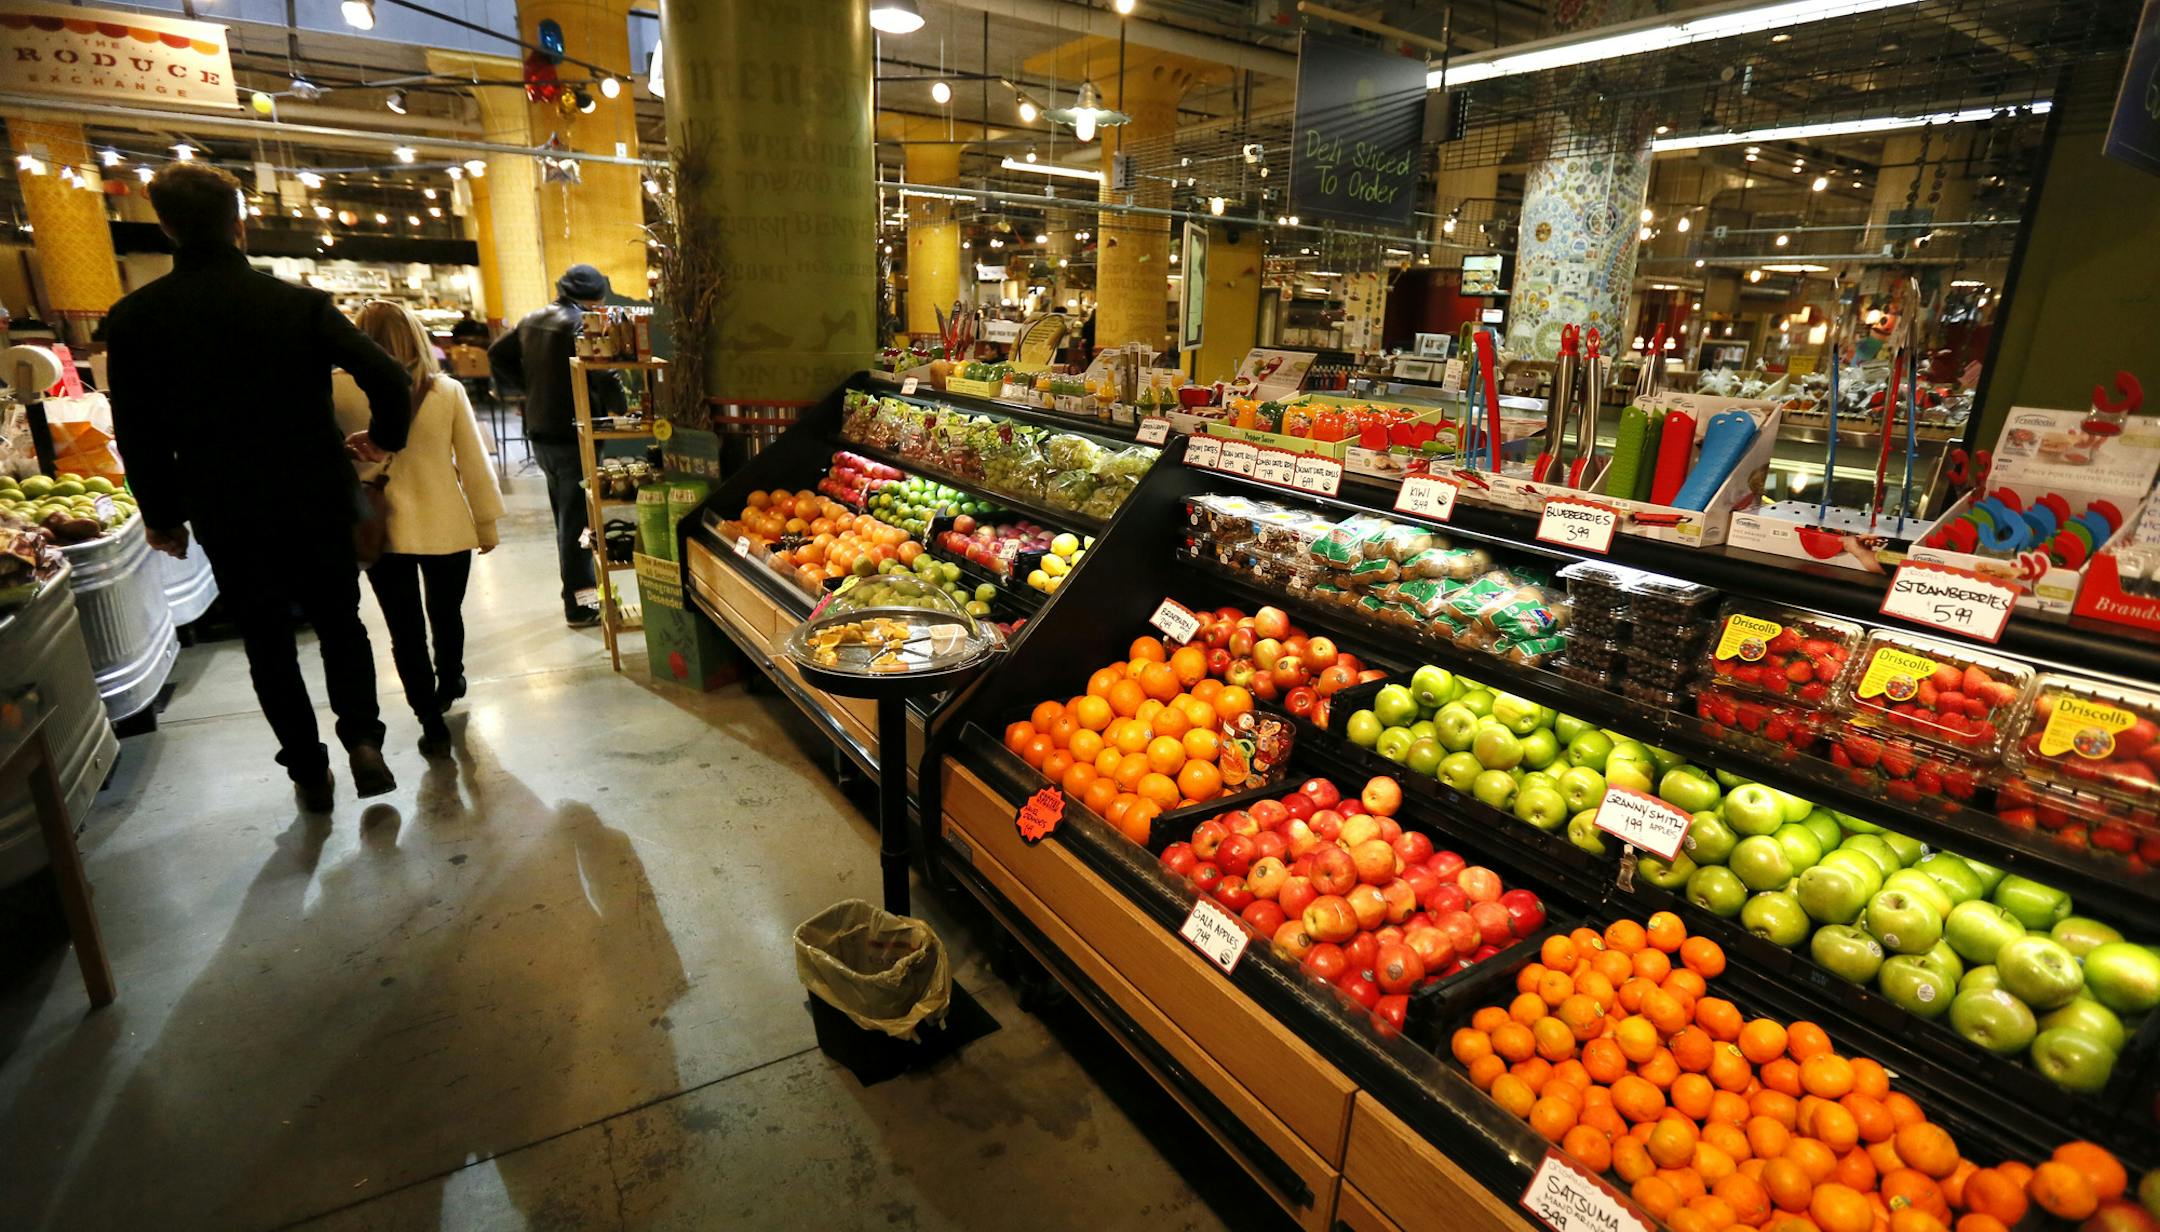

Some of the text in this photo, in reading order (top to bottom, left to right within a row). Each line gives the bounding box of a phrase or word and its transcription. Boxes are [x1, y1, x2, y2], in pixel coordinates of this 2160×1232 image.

[83, 38, 120, 50] THE
[28, 74, 187, 97] EXCHANGE
[1306, 129, 1411, 176] Deli Sliced
[1315, 165, 1398, 204] To Order
[1410, 486, 1430, 498] KIWI
[1546, 505, 1611, 526] BLUEBERRIES
[1895, 580, 2009, 610] STRAWBERRIES
[1648, 810, 1684, 831] SMITH
[1649, 823, 1678, 840] APPLES
[1193, 909, 1240, 951] GALA APPLES
[1547, 1175, 1618, 1232] SATSUMA
